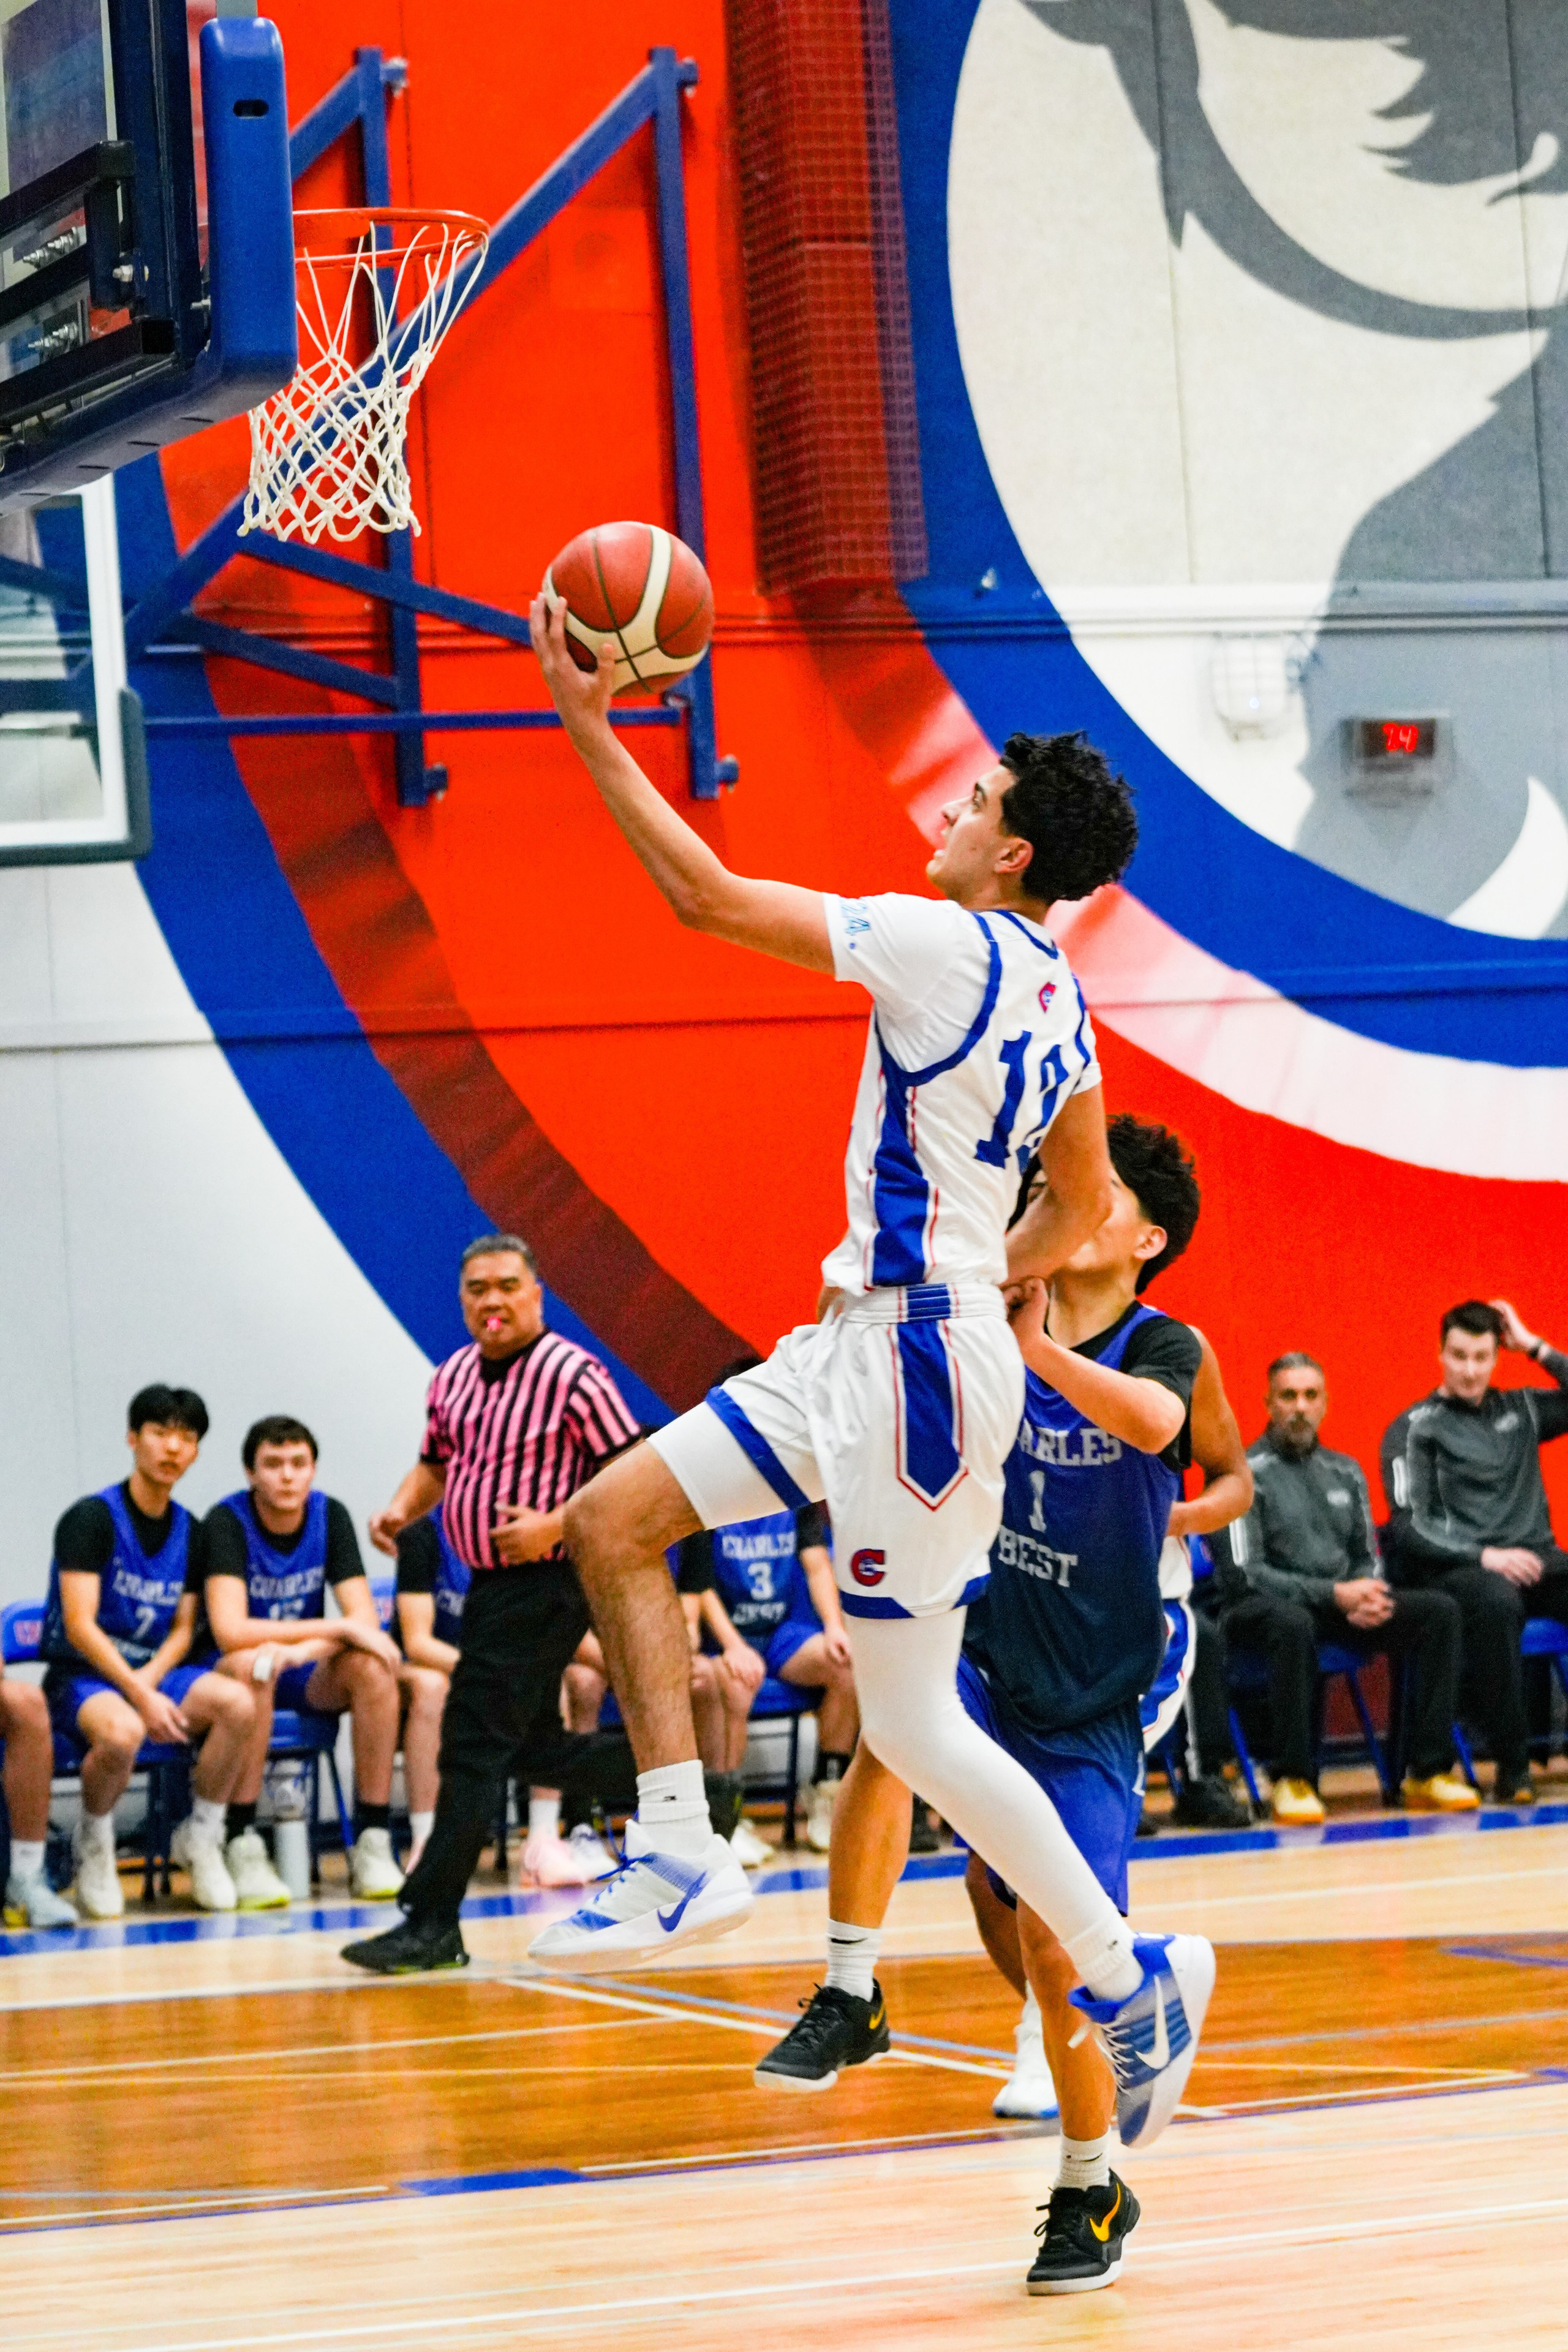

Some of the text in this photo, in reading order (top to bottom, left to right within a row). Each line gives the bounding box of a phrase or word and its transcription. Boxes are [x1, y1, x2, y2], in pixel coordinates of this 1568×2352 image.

[1017, 1417, 1122, 1466] ARLES
[1028, 1469, 1047, 1533] 1
[998, 1524, 1078, 1588] BEST
[748, 1562, 774, 1600] 3
[134, 1604, 157, 1640] 7
